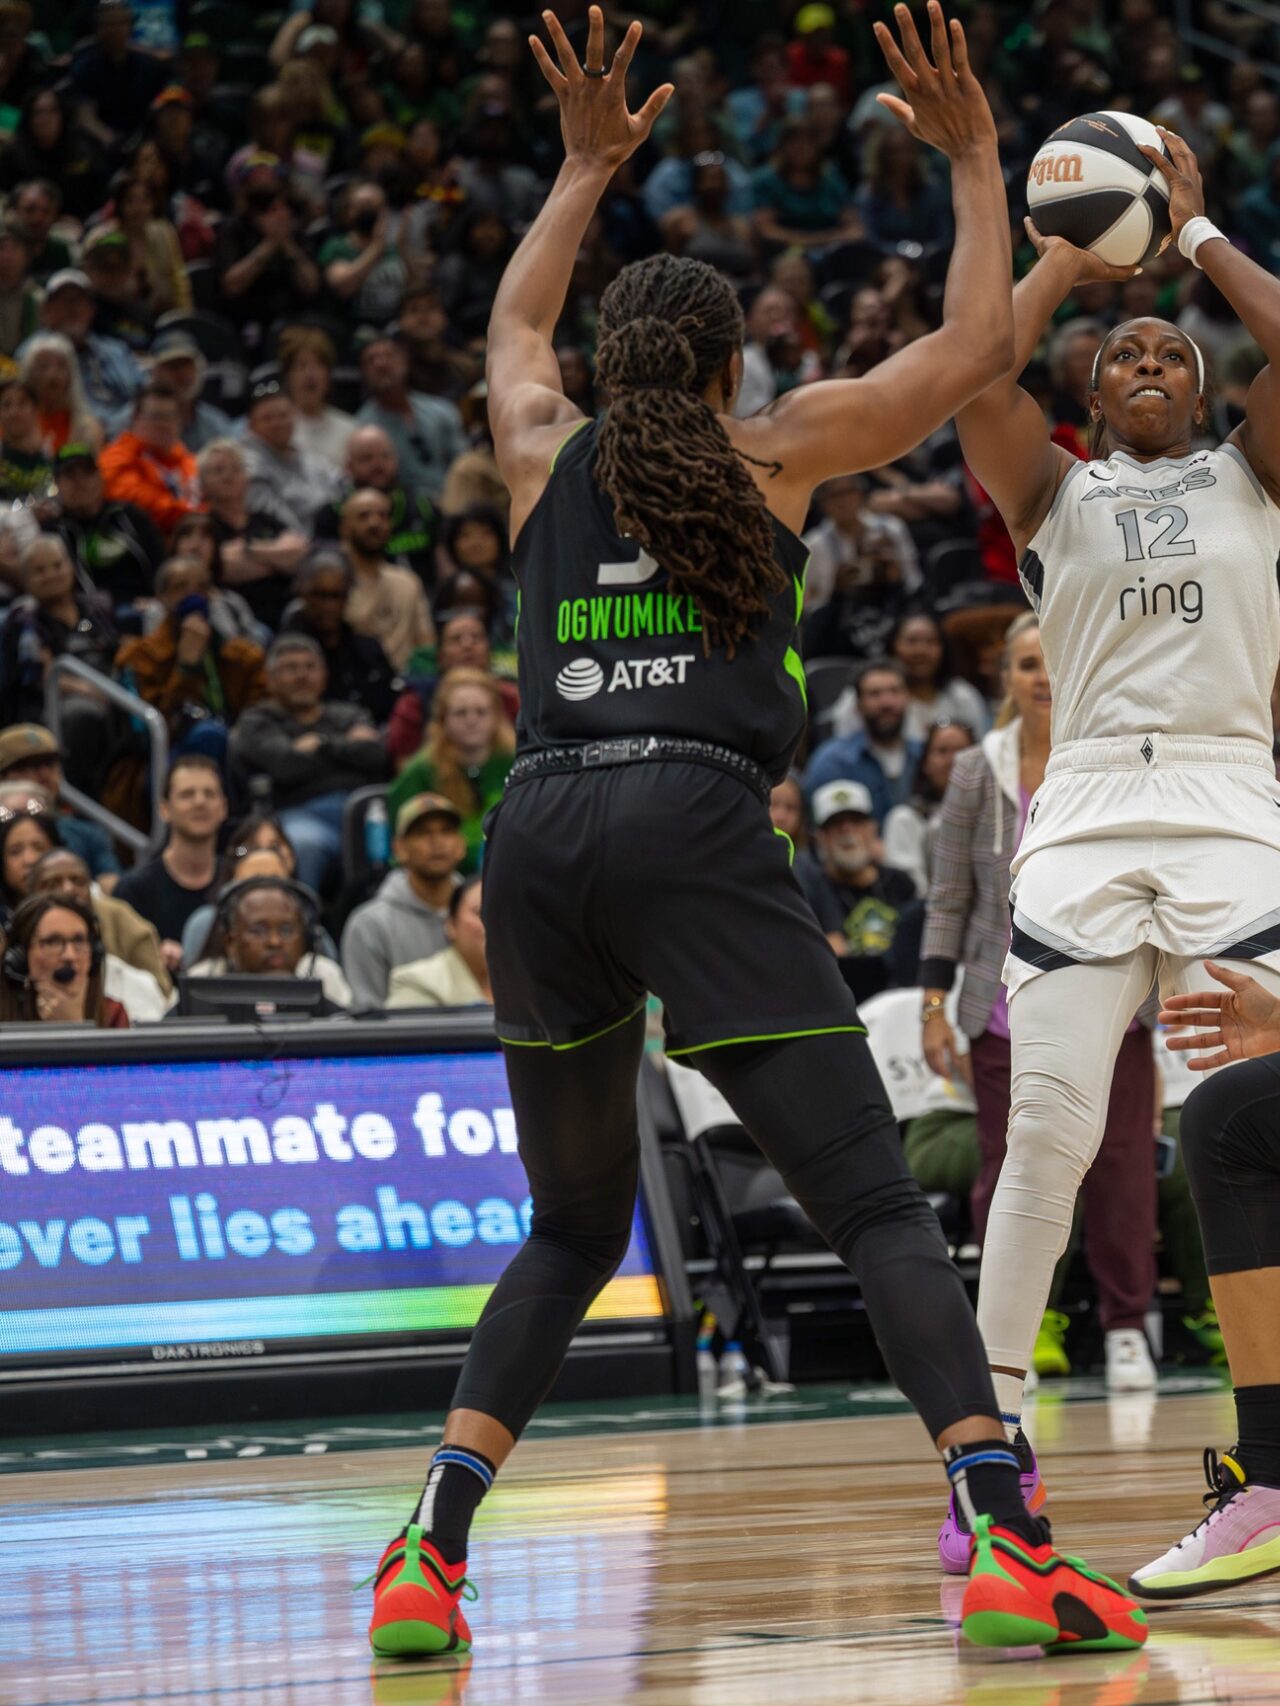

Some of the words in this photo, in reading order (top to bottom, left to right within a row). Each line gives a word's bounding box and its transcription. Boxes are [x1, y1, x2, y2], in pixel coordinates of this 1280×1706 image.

[1081, 467, 1217, 501] ACES
[1115, 505, 1196, 562] 12
[557, 592, 703, 643] OGWUMIKE
[1119, 576, 1203, 624] ring
[607, 654, 696, 693] AT&T
[0, 1103, 398, 1174] teammate
[413, 1092, 519, 1156] for
[169, 1192, 316, 1261] lies
